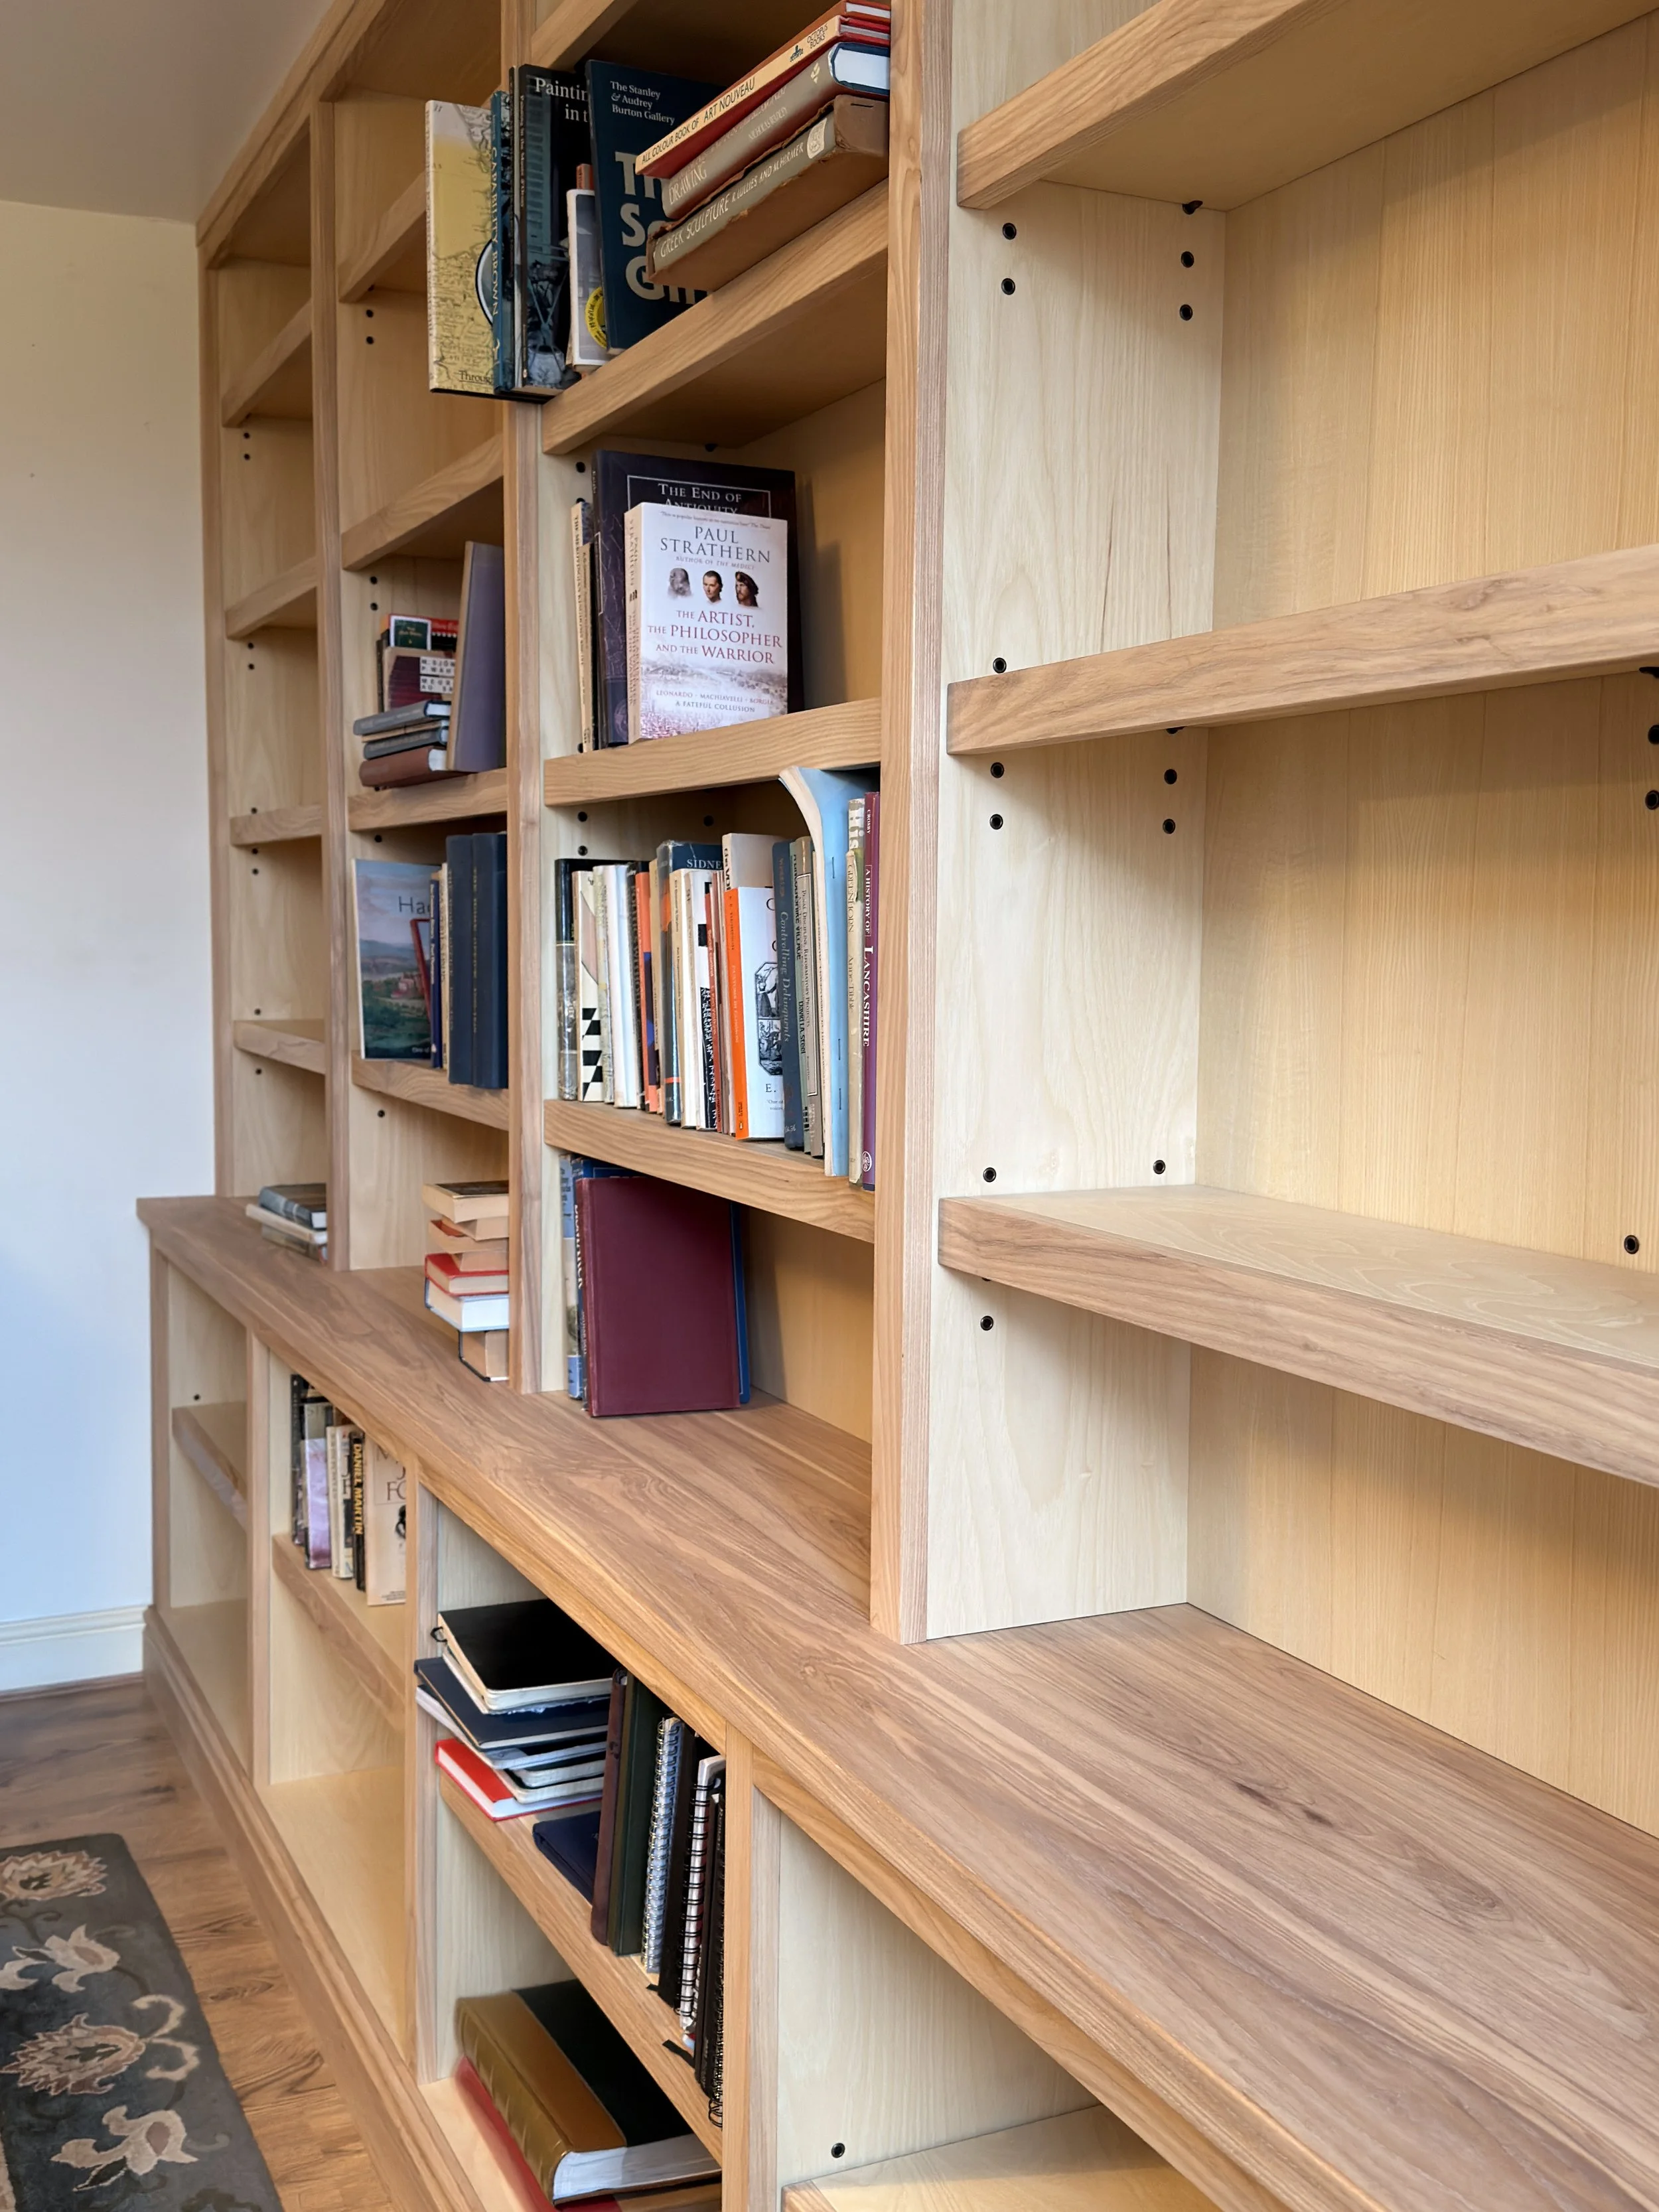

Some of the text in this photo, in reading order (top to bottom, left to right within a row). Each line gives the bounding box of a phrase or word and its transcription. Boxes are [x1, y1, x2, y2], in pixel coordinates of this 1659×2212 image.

[807, 23, 828, 44] OCTOPUS
[810, 33, 826, 48] BOOKS
[611, 80, 661, 100] The Stanley
[611, 92, 652, 110] & Audrey
[565, 103, 579, 121] in
[612, 104, 675, 125] Burton Gallery
[642, 152, 652, 165] ALL
[652, 135, 674, 156] COLOUR
[674, 124, 690, 141] BOOK
[691, 117, 699, 129] OF
[703, 104, 718, 123] ART
[719, 77, 755, 110] NOUVEAU
[668, 165, 707, 205] DRAWING
[660, 232, 684, 258] GREEK
[686, 196, 730, 240] SCULPTURE
[737, 175, 758, 200] LULLIES
[758, 165, 772, 184] AND
[780, 142, 804, 167] HIRMER
[658, 483, 741, 503] THE END OF
[695, 526, 739, 544] PAUL
[660, 538, 770, 563] STRATHERN
[676, 610, 695, 619] THE
[648, 625, 782, 648] THE PHILOSOPHER
[680, 646, 698, 654] THE
[702, 645, 775, 664] WARRIOR
[656, 690, 693, 698] LEONARDO
[700, 694, 743, 703] MACHIAVELLI
[714, 704, 755, 713] COLLUSION
[687, 858, 723, 869] SIDNE
[865, 925, 871, 936] OF
[780, 911, 791, 1043] Controlling Delinquents
[863, 946, 873, 1047] LANCASHIRE
[765, 1083, 776, 1092] E.
[353, 1443, 363, 1535] DANIEL MARTIN
